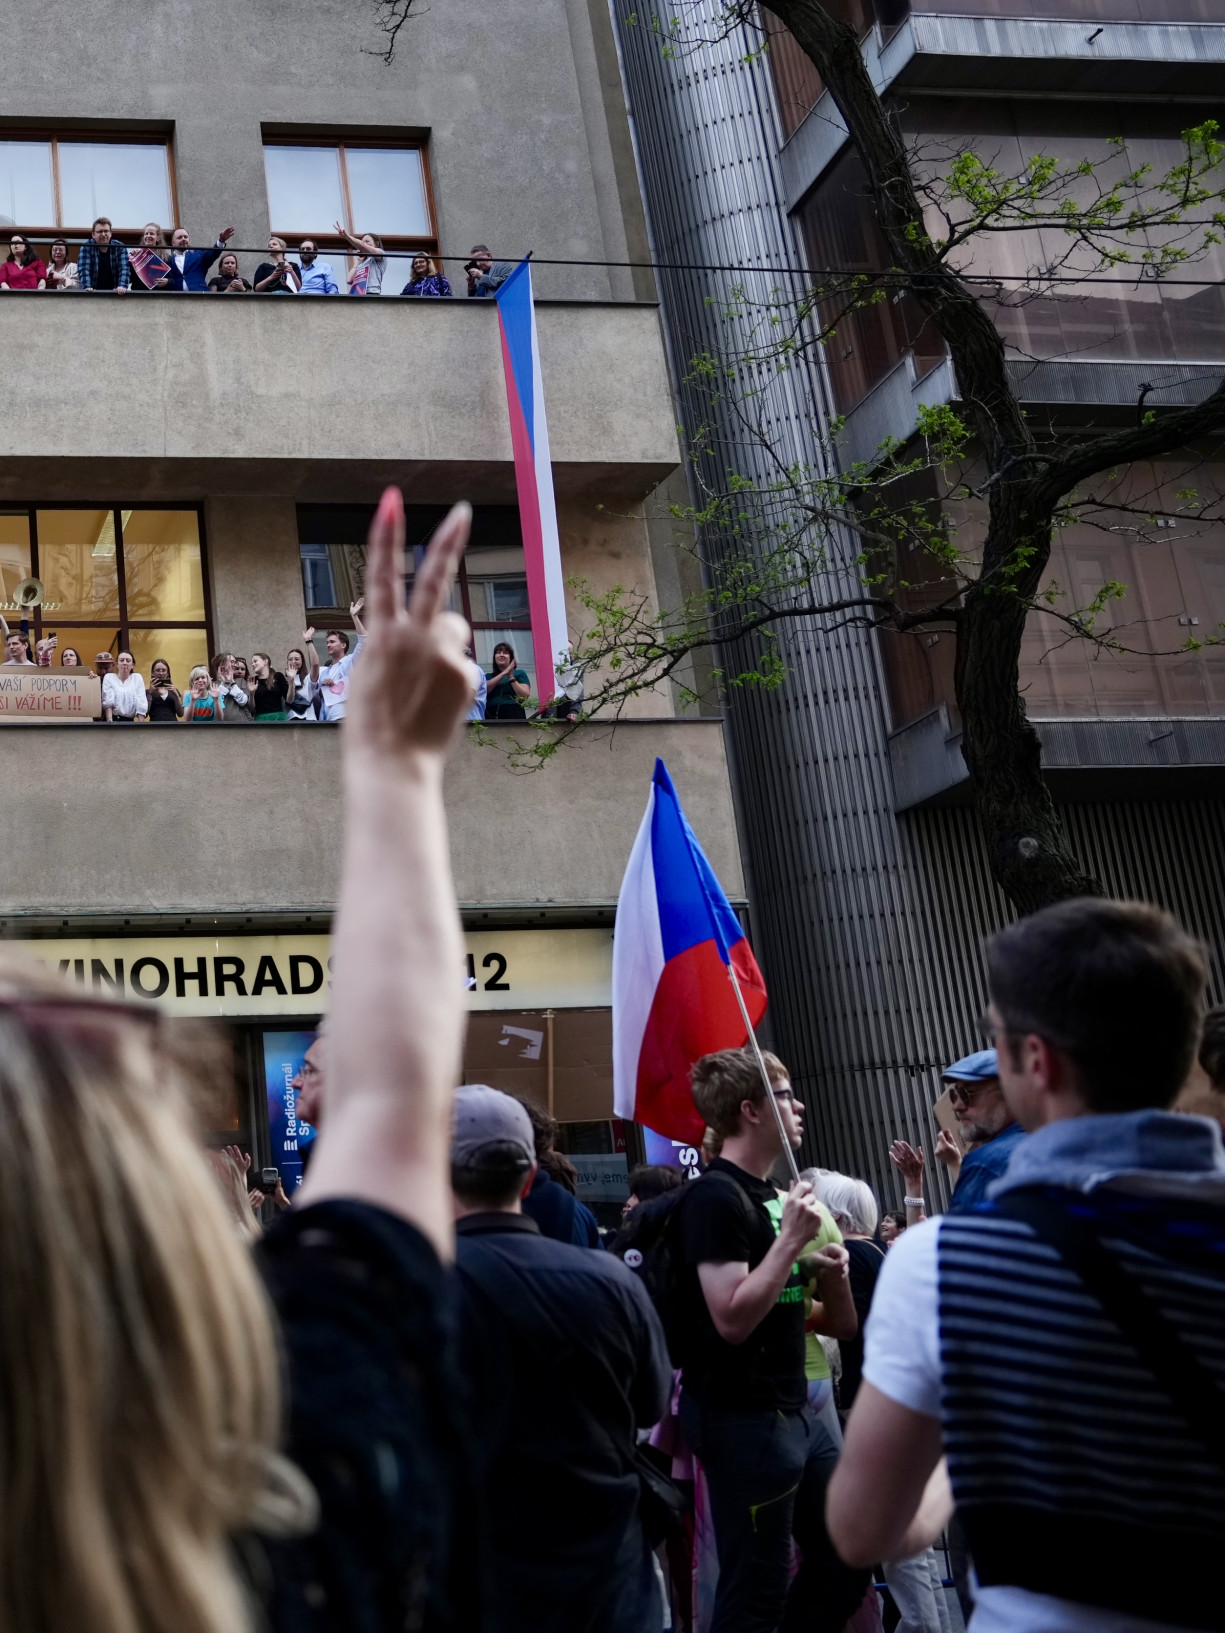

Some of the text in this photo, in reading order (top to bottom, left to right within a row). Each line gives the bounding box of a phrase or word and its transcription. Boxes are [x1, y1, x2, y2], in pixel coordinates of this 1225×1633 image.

[31, 678, 77, 692] PODPORY
[16, 694, 63, 711] VÁŽÍME
[67, 695, 82, 711] !!!
[34, 953, 336, 1000] INOHRAD
[466, 952, 511, 991] 12
[282, 1062, 297, 1137] Radiožurnál
